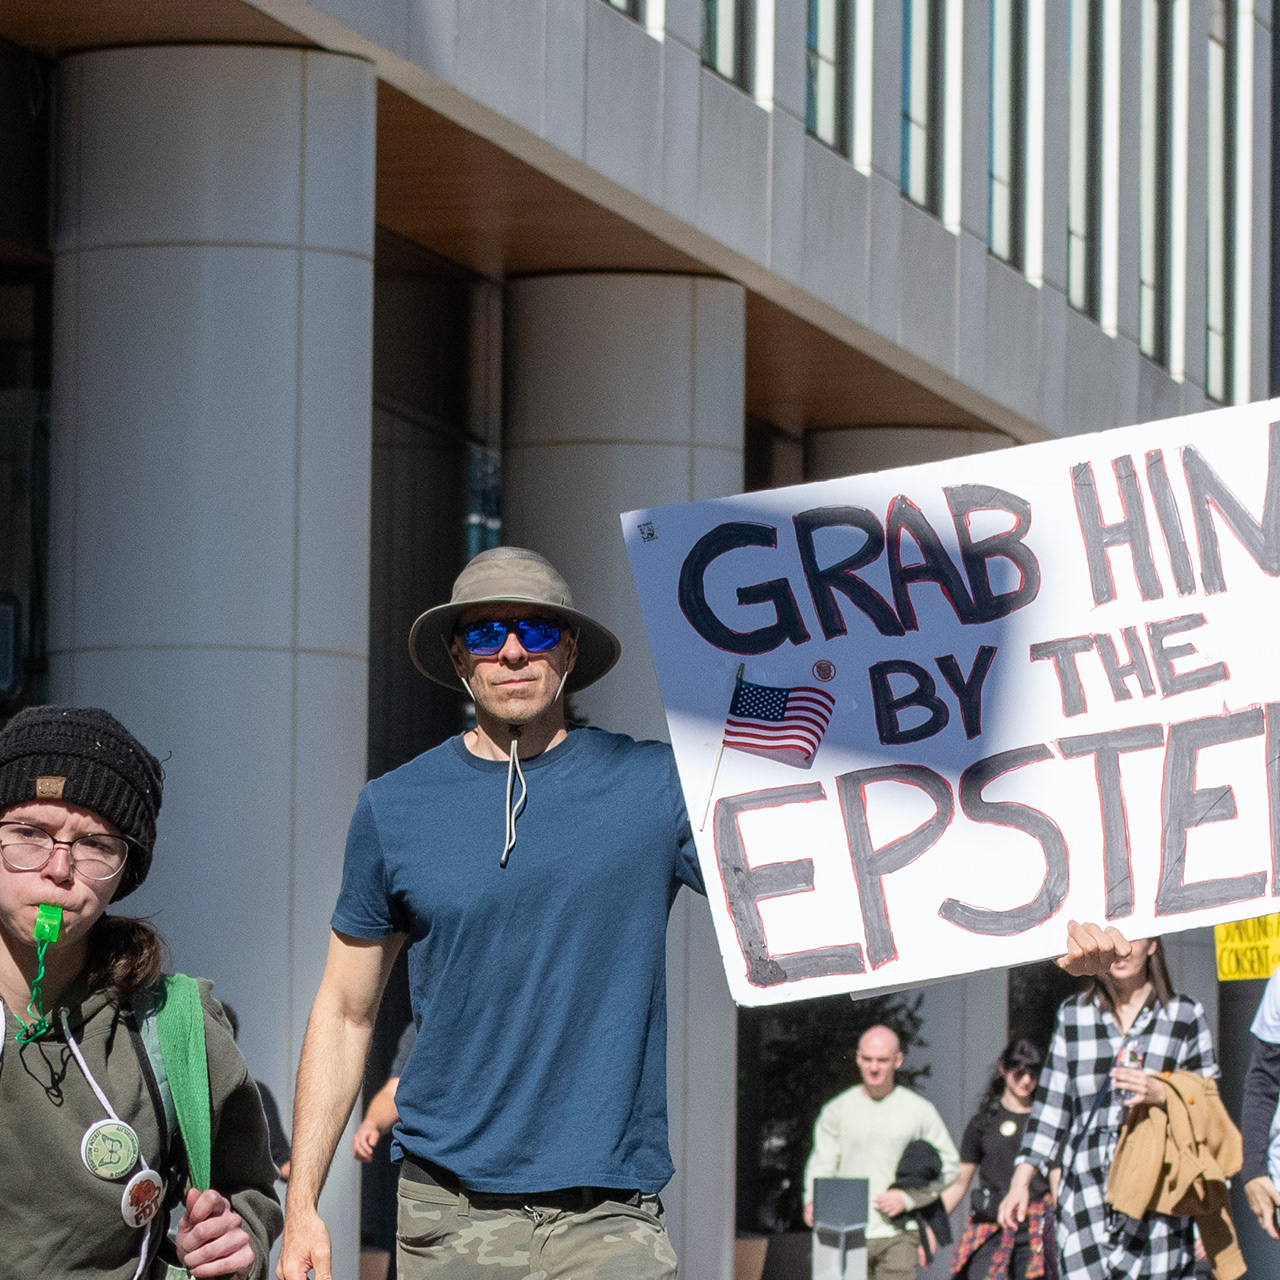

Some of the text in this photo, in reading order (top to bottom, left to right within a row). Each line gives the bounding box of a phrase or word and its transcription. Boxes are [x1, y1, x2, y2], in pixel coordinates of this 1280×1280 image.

[677, 482, 1042, 656] GRAB
[868, 612, 1230, 746] BY THE
